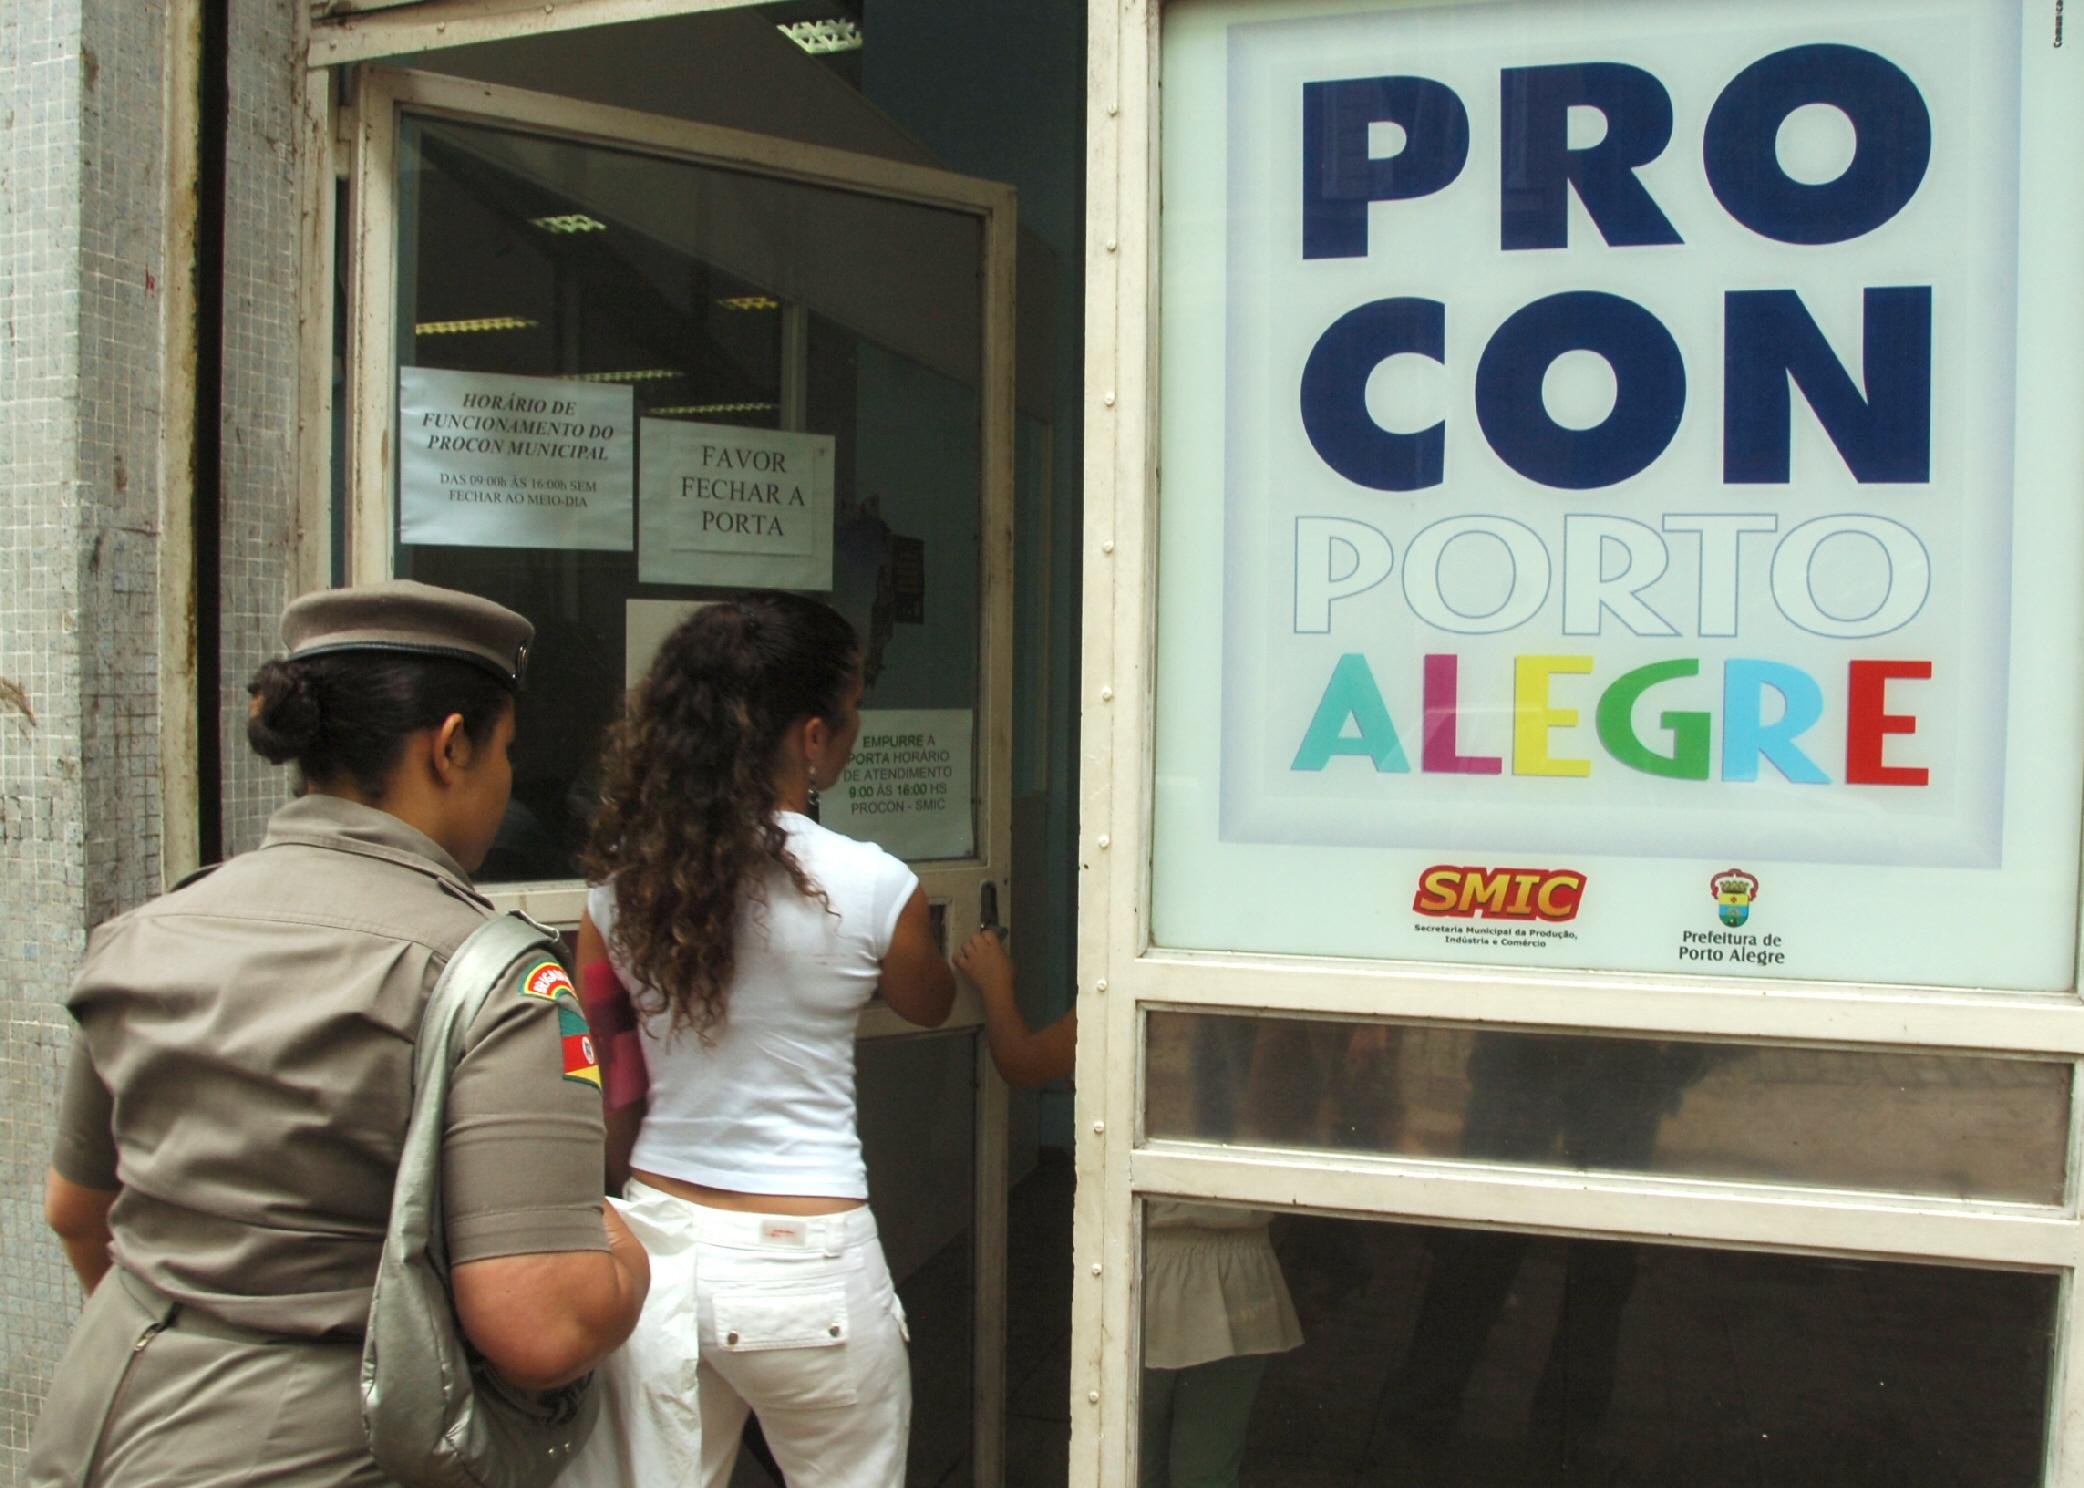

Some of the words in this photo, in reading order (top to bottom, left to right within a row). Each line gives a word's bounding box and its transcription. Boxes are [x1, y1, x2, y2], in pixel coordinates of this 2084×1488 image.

[1302, 43, 1931, 260] PRO
[1300, 285, 1932, 491] CON
[463, 392, 547, 414] HORÁRIO
[551, 401, 577, 416] DE
[422, 412, 585, 438] FUNCIONAMENTO
[588, 424, 614, 439] DO
[427, 434, 504, 454] PROCON
[507, 440, 609, 461] MUNICIPAL
[702, 445, 786, 473] FAVOR
[439, 472, 466, 486] DAS
[570, 480, 597, 493] SEM
[681, 475, 781, 505] FECHAR
[788, 485, 805, 507] A
[449, 489, 502, 504] FECHAR
[505, 494, 525, 505] AO
[527, 494, 588, 508] MEIO-DIA
[702, 510, 784, 537] PORTA
[1293, 512, 1931, 639] PORTO
[1290, 652, 1932, 786] ALEGRE
[862, 734, 924, 748] EMPURRE
[927, 735, 936, 746] A
[848, 752, 890, 766] PORTA
[843, 769, 860, 783] DE
[864, 766, 953, 781] ATENDIMENTO
[849, 785, 874, 798] 9:00
[930, 782, 948, 795] HS
[851, 802, 905, 816] PROCON
[914, 799, 946, 812] SMIC
[1419, 870, 1580, 917] SMIC
[1414, 924, 1464, 934] Secretaria
[1465, 927, 1513, 937] Municipal
[1515, 929, 1528, 937] da
[1445, 935, 1490, 946] Indústria
[1501, 938, 1547, 948] Comércio
[1682, 930, 1758, 946] Prefeitura
[1763, 933, 1782, 947] de
[1679, 946, 1724, 962] Porto
[1729, 947, 1786, 966] Alegre
